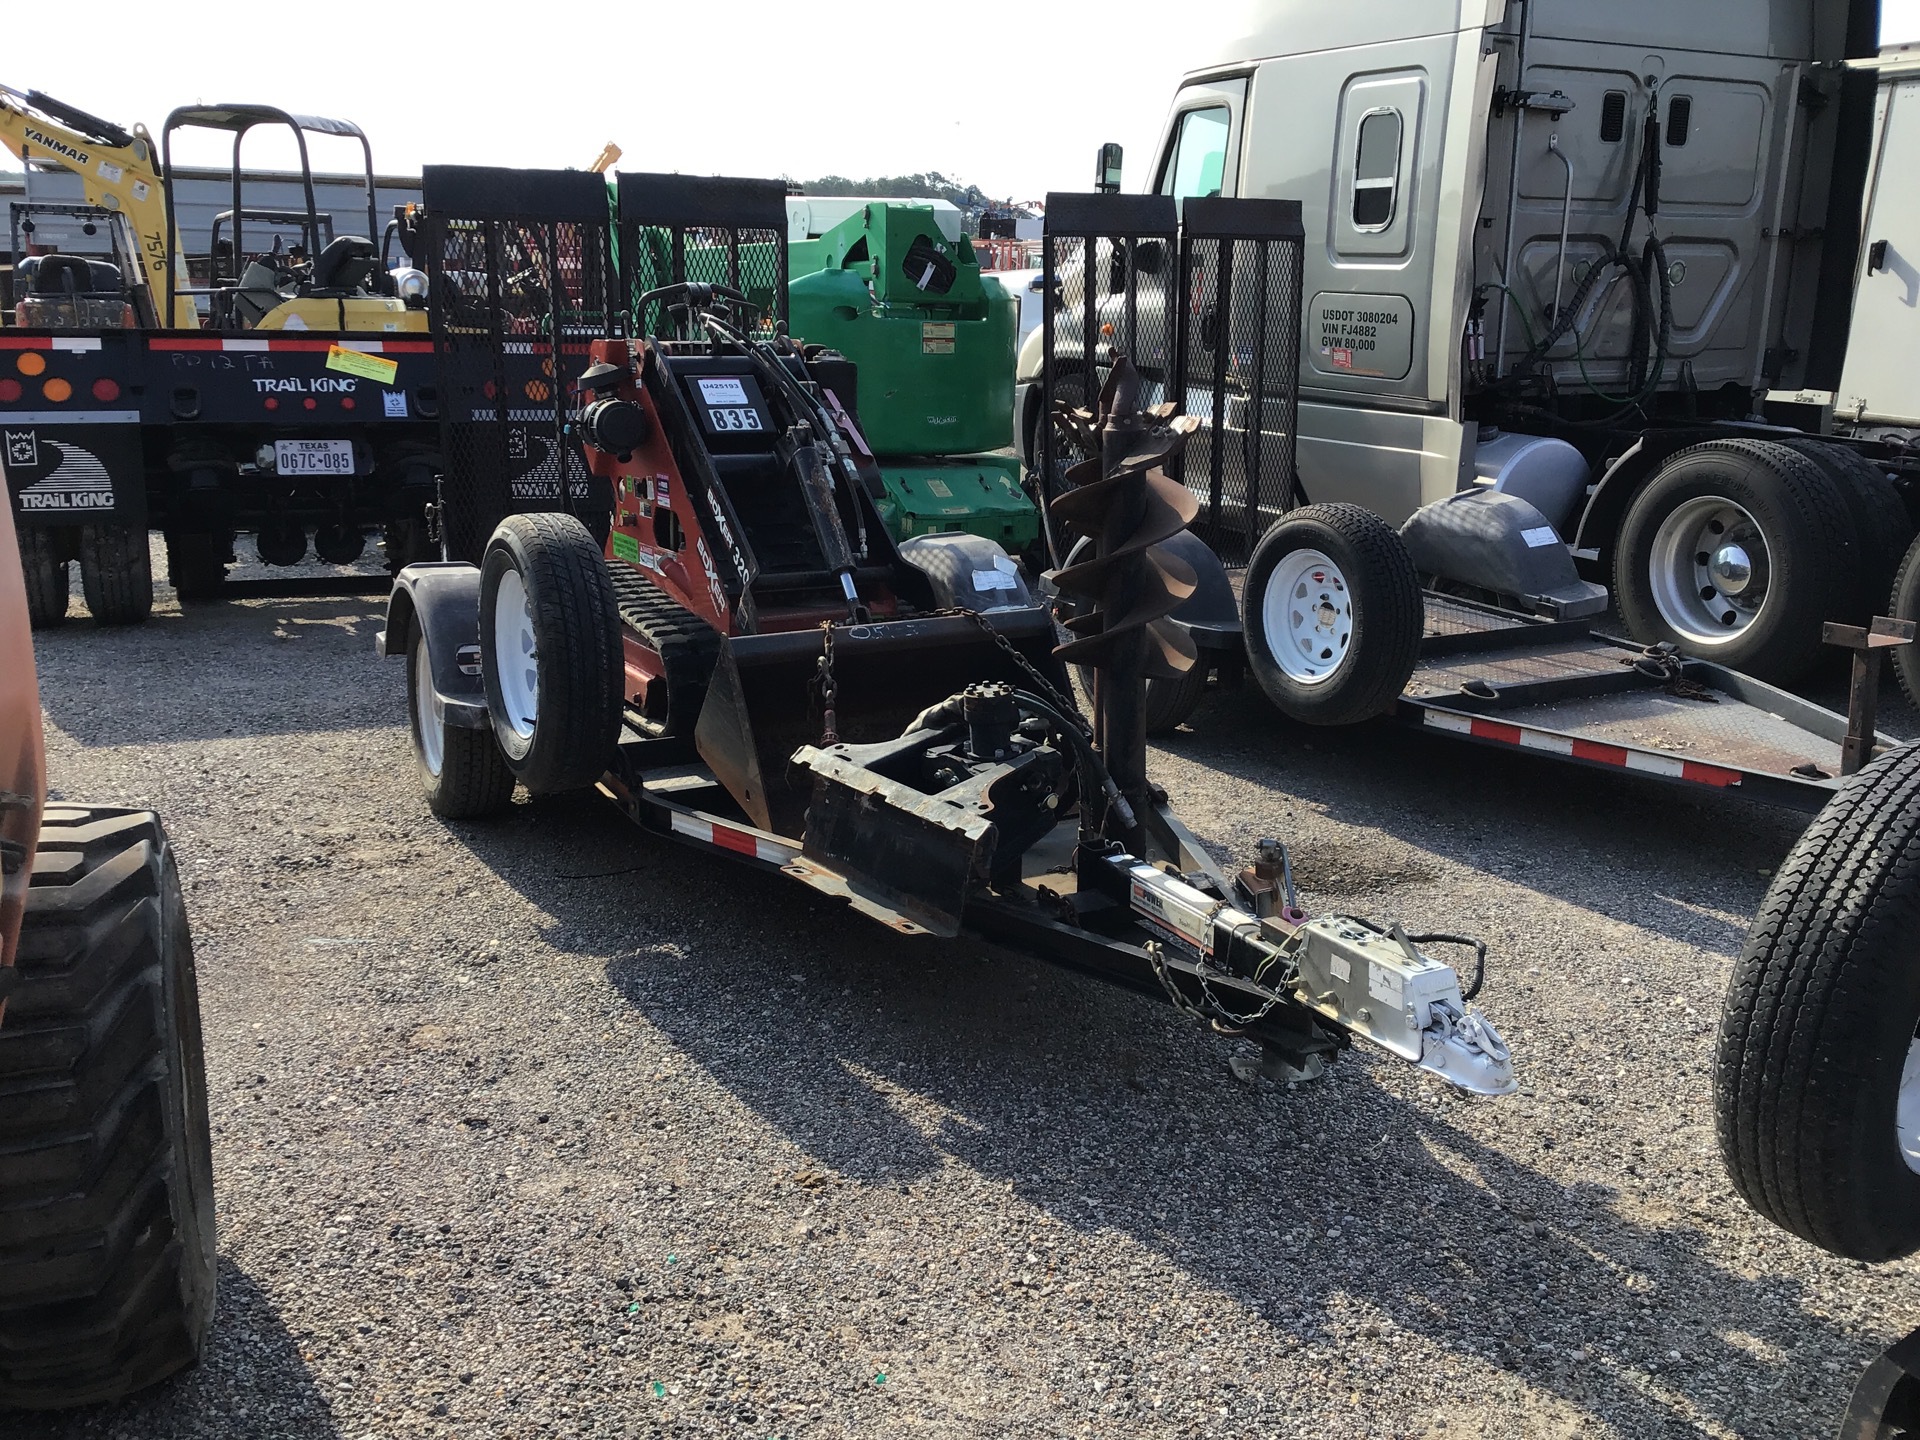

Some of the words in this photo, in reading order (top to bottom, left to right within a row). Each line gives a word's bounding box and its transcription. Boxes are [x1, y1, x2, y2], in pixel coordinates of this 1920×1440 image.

[24, 127, 90, 164] YANMAR
[143, 231, 168, 271] 7576
[1322, 309, 1354, 321] USDOT
[1356, 311, 1398, 325] 3080204
[1321, 322, 1339, 334] VIN
[1341, 324, 1377, 337] FJ4882
[1321, 336, 1342, 348] GVW
[1344, 338, 1376, 351] 80,000
[712, 409, 759, 429] 835
[299, 442, 329, 450] TEXAS
[706, 487, 735, 549] BOXER
[732, 546, 750, 585] 320
[696, 536, 727, 613] BOXER
